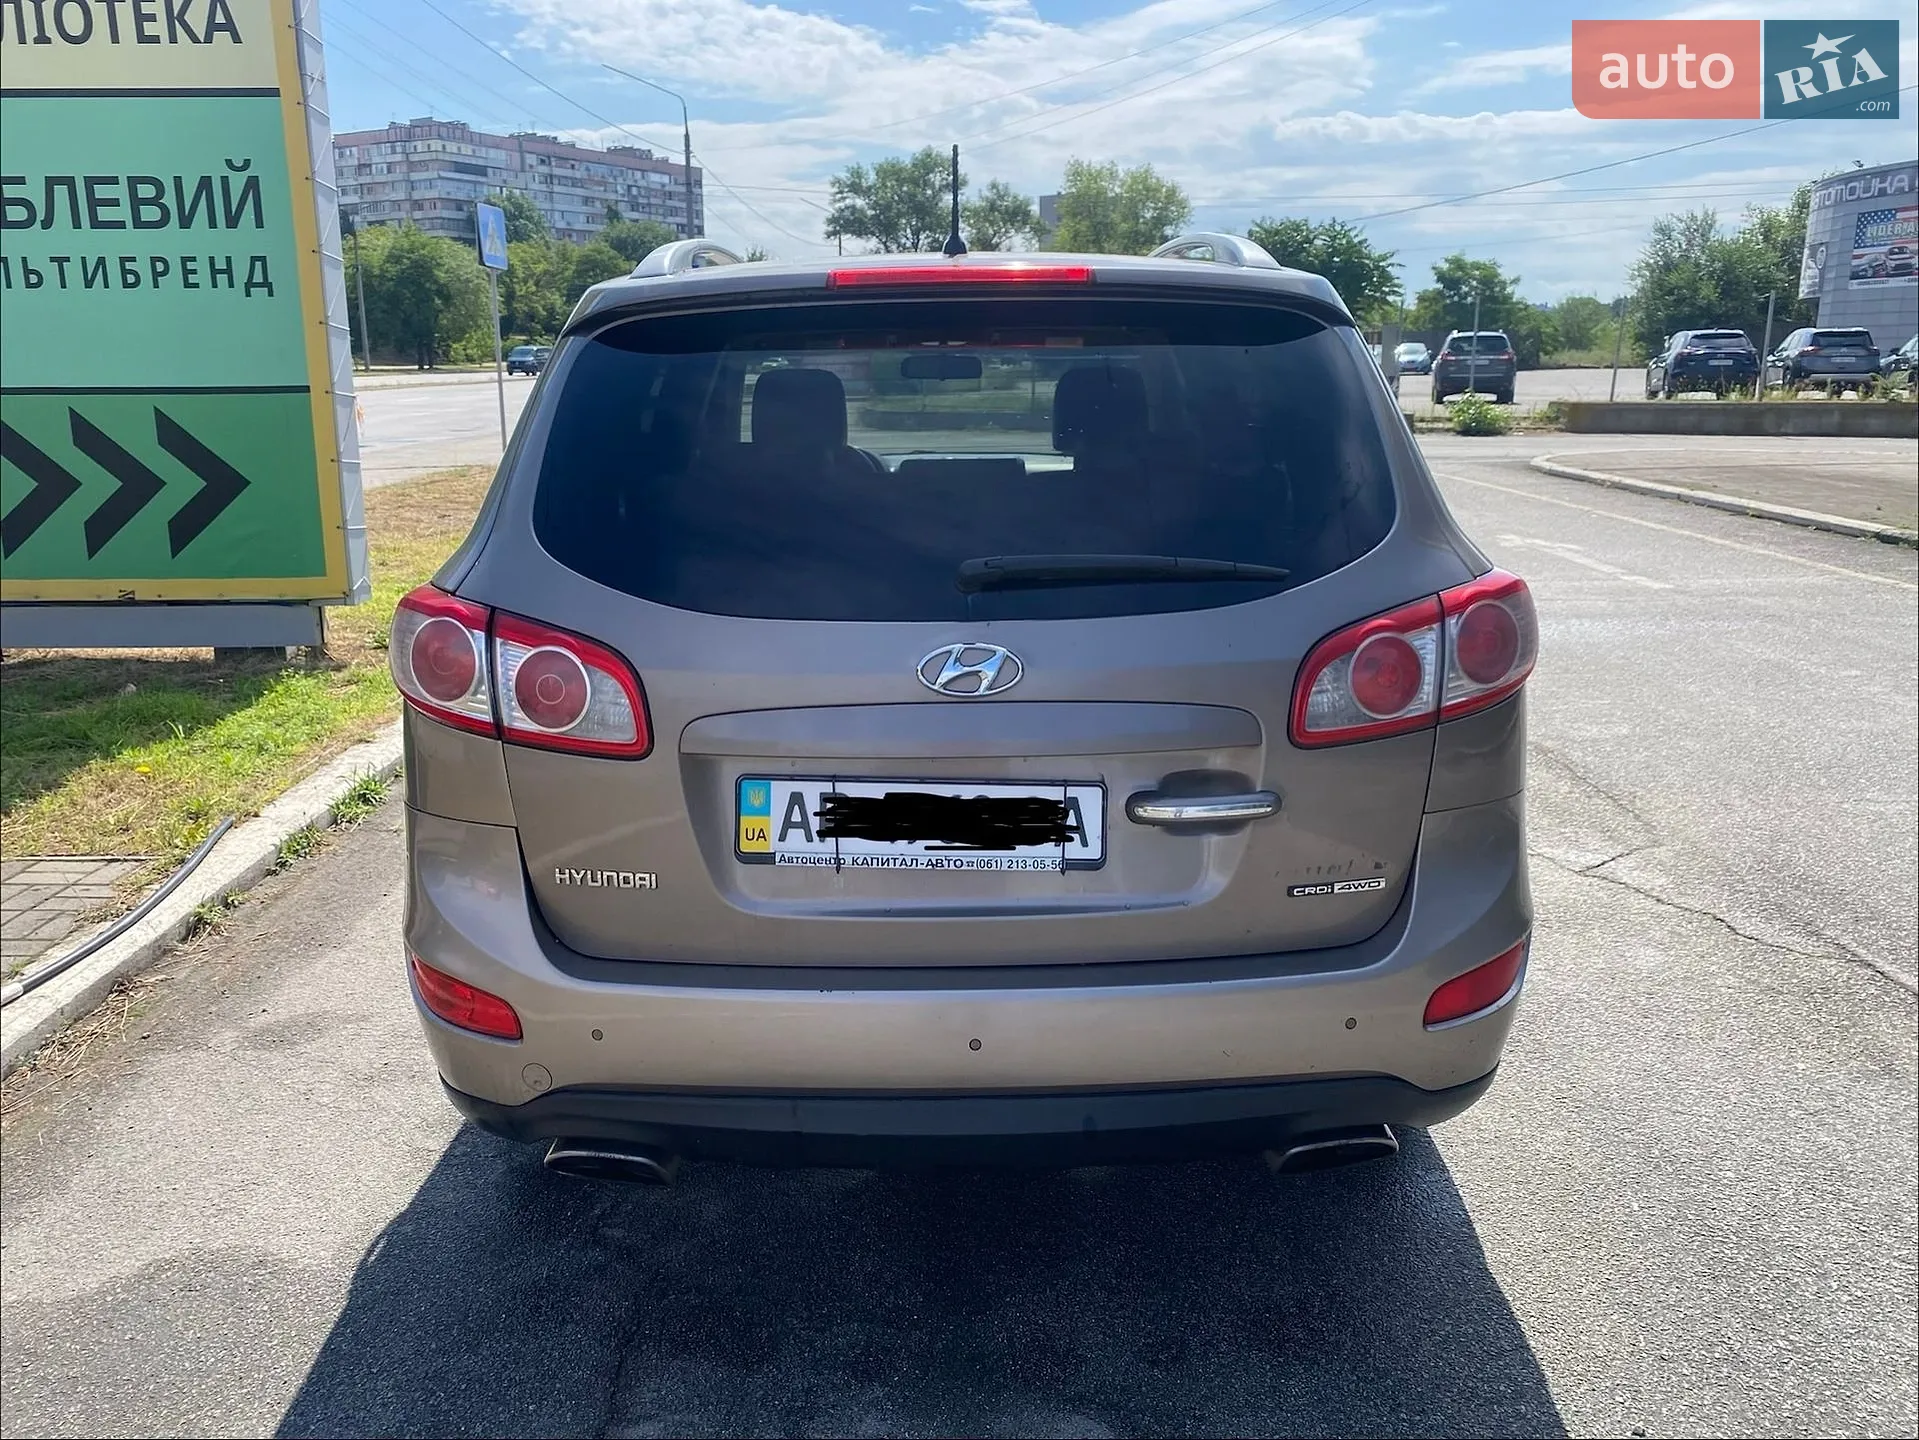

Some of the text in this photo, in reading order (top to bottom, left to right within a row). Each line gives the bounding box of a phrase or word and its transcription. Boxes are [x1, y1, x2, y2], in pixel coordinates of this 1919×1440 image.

[1, 158, 265, 230] БЛЕВИЙ
[744, 827, 768, 842] UA
[852, 855, 964, 870] КАПИТАЛ-АВТО
[554, 867, 659, 890] HYUNDAI
[1337, 880, 1381, 891] 4WD
